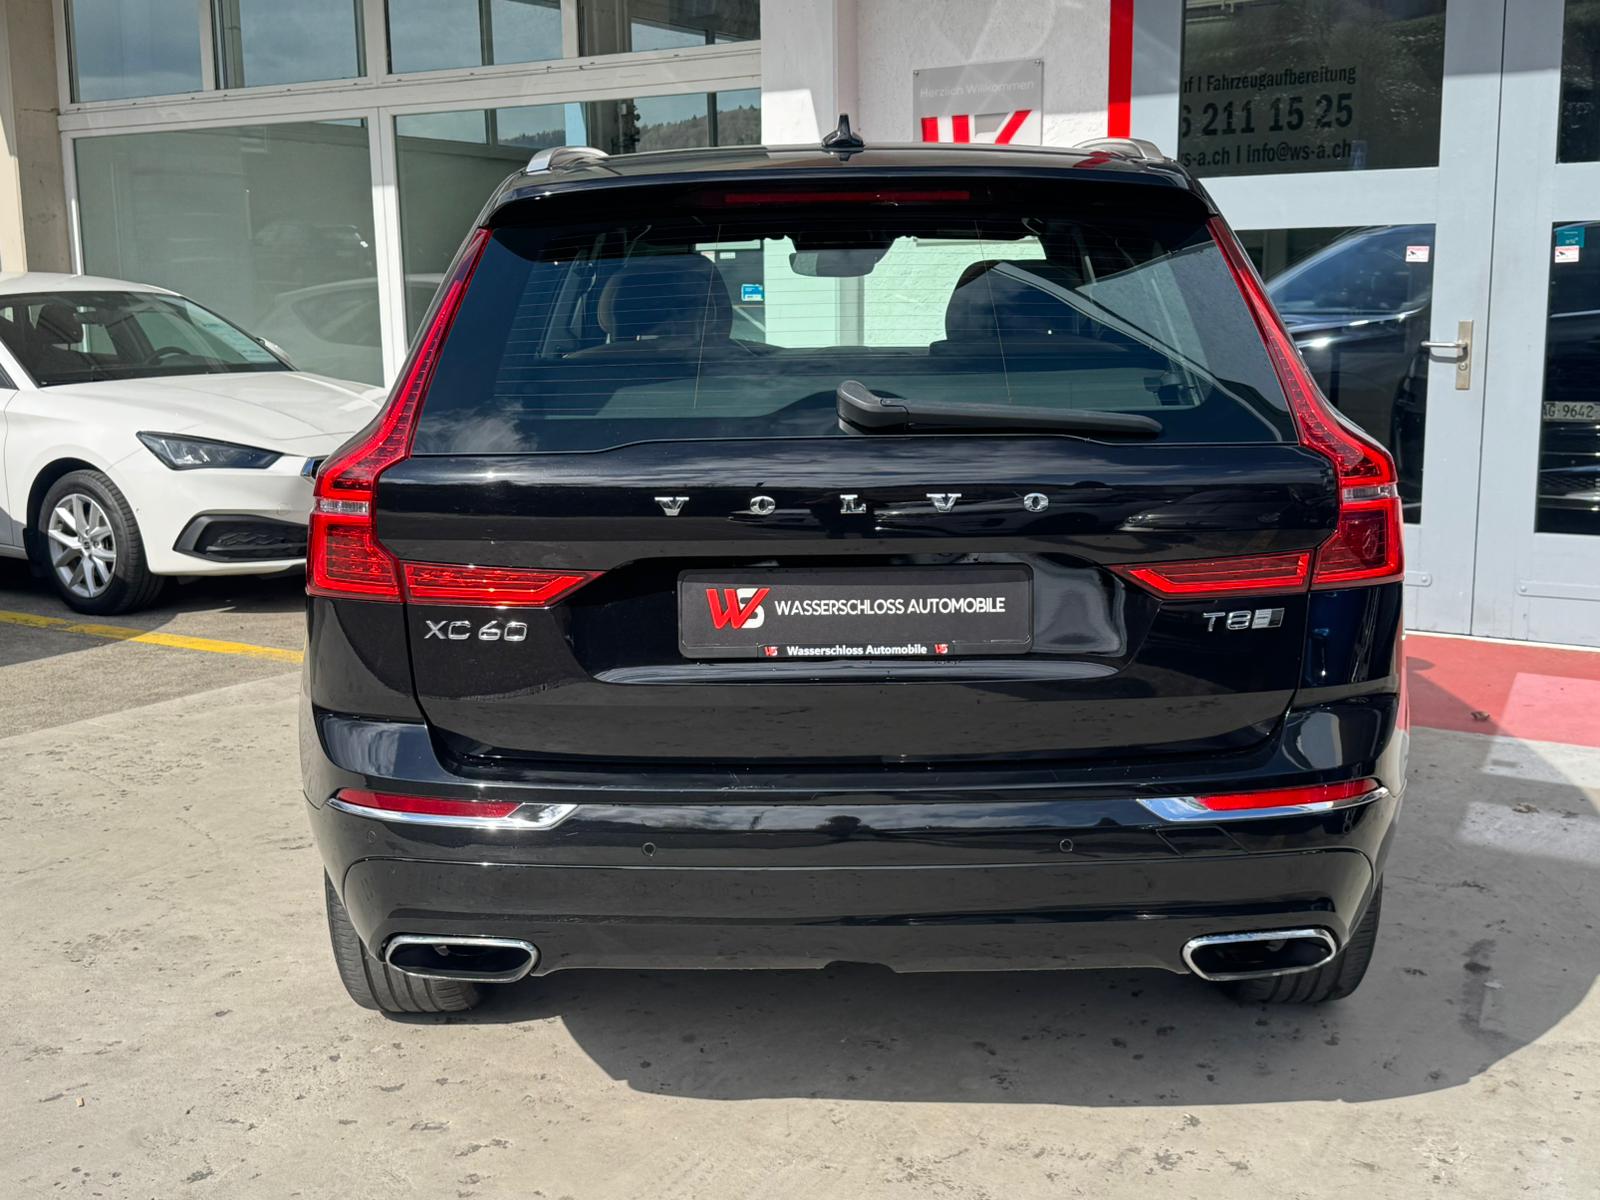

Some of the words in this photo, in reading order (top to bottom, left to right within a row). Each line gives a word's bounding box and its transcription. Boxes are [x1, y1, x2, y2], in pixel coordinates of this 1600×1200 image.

[920, 86, 964, 98] Herzlich
[966, 80, 1035, 96] Willkommen
[1207, 66, 1356, 91] Fahrzeugaufbereitung
[1202, 101, 1255, 136] 211
[1269, 97, 1304, 132] 15
[1315, 93, 1353, 129] 25
[1247, 139, 1351, 163] info@ws-a.ch
[654, 492, 1049, 516] VOLVO
[775, 598, 904, 616] WASSERSCHLOSS
[907, 597, 1006, 614] AUTOMOBILE
[424, 620, 471, 640] XC
[478, 620, 528, 642] 60
[1203, 610, 1252, 632] T8
[787, 645, 862, 657] Wasserschloss
[866, 644, 928, 655] Automobile
